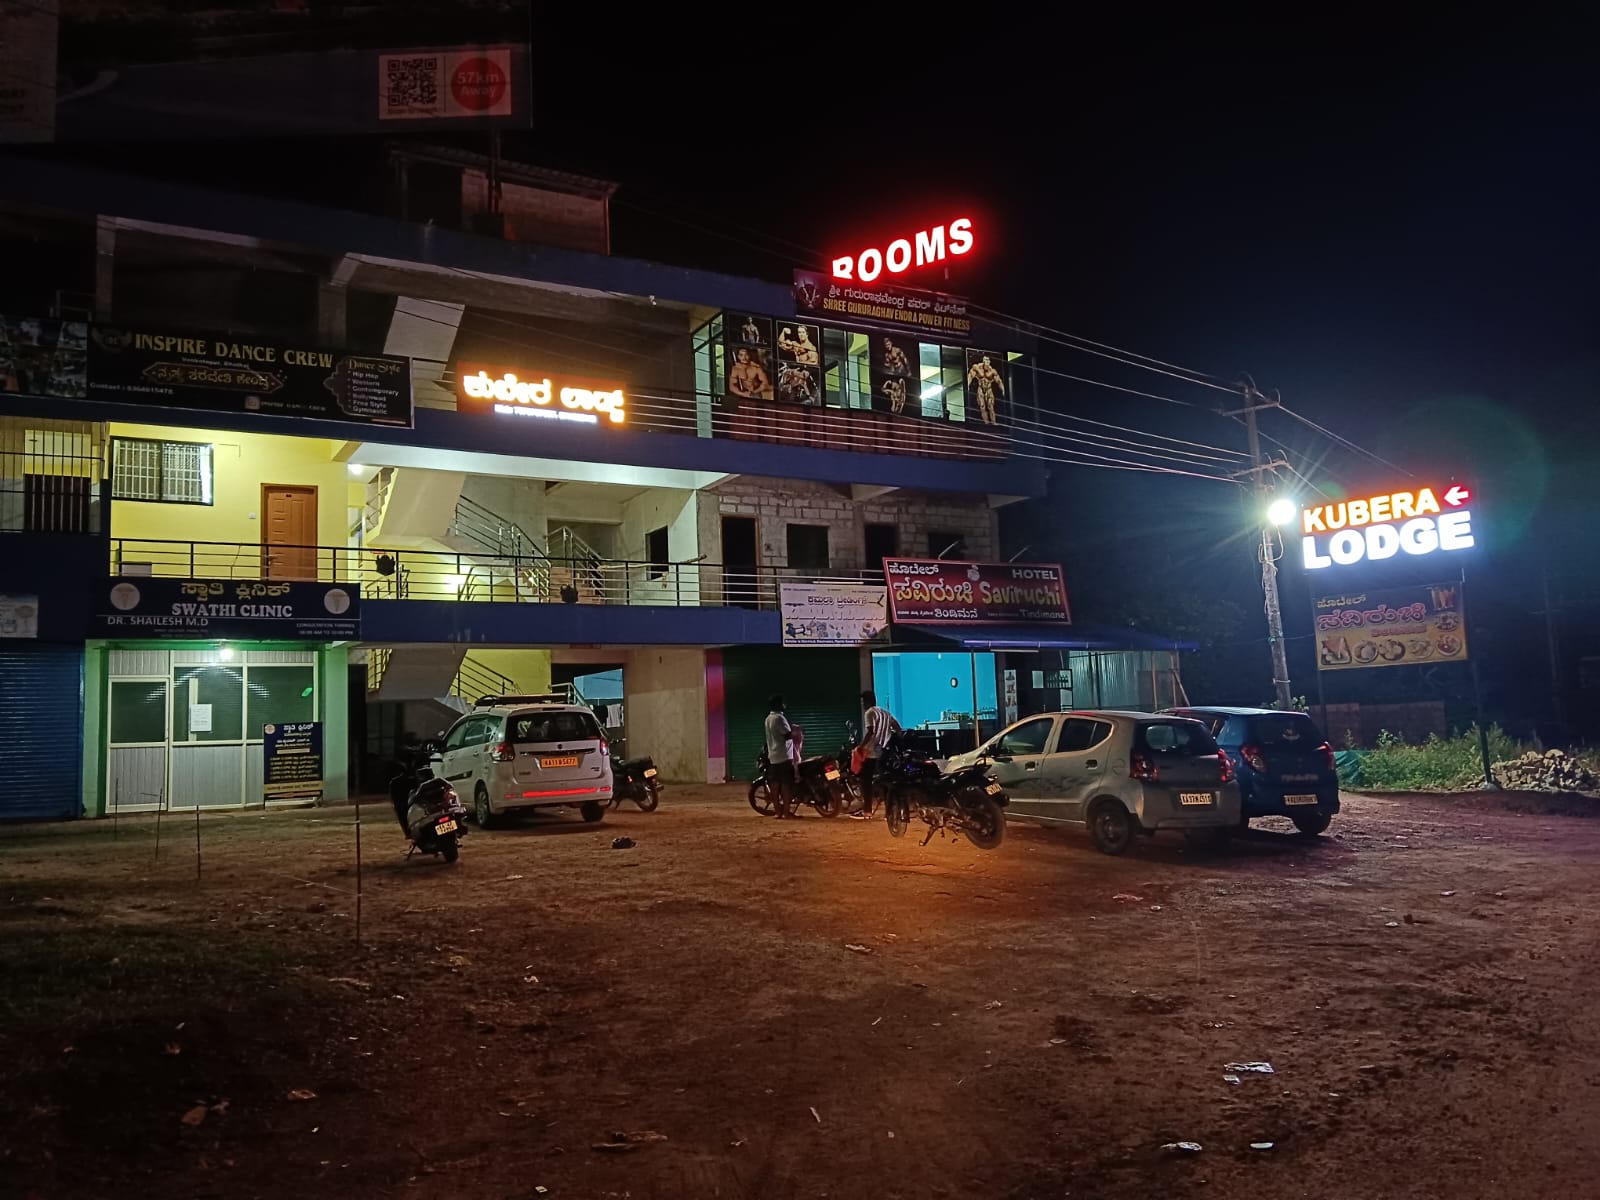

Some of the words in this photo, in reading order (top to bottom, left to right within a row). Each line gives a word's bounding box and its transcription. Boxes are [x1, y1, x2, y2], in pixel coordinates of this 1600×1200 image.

[461, 86, 496, 98] Away
[832, 218, 974, 282] ROOMS
[823, 298, 847, 312] SHREE
[918, 313, 944, 328] POWER
[943, 316, 970, 331] FITNESS
[135, 333, 208, 355] INSPIRE
[215, 342, 277, 363] DANCE
[283, 349, 334, 369] CREW
[349, 358, 376, 370] Dance
[377, 362, 401, 375] Style
[1303, 488, 1440, 533] KUBERA
[1303, 511, 1475, 569] LODGE
[1012, 569, 1058, 581] HOTEL
[893, 576, 974, 604] ಸವಿರುಚಿ
[979, 580, 1062, 606] Saviruchi
[107, 616, 126, 625] DR.
[130, 616, 183, 627] SHAILESH
[171, 603, 236, 617] SWATHI
[240, 604, 293, 618] CLINIC
